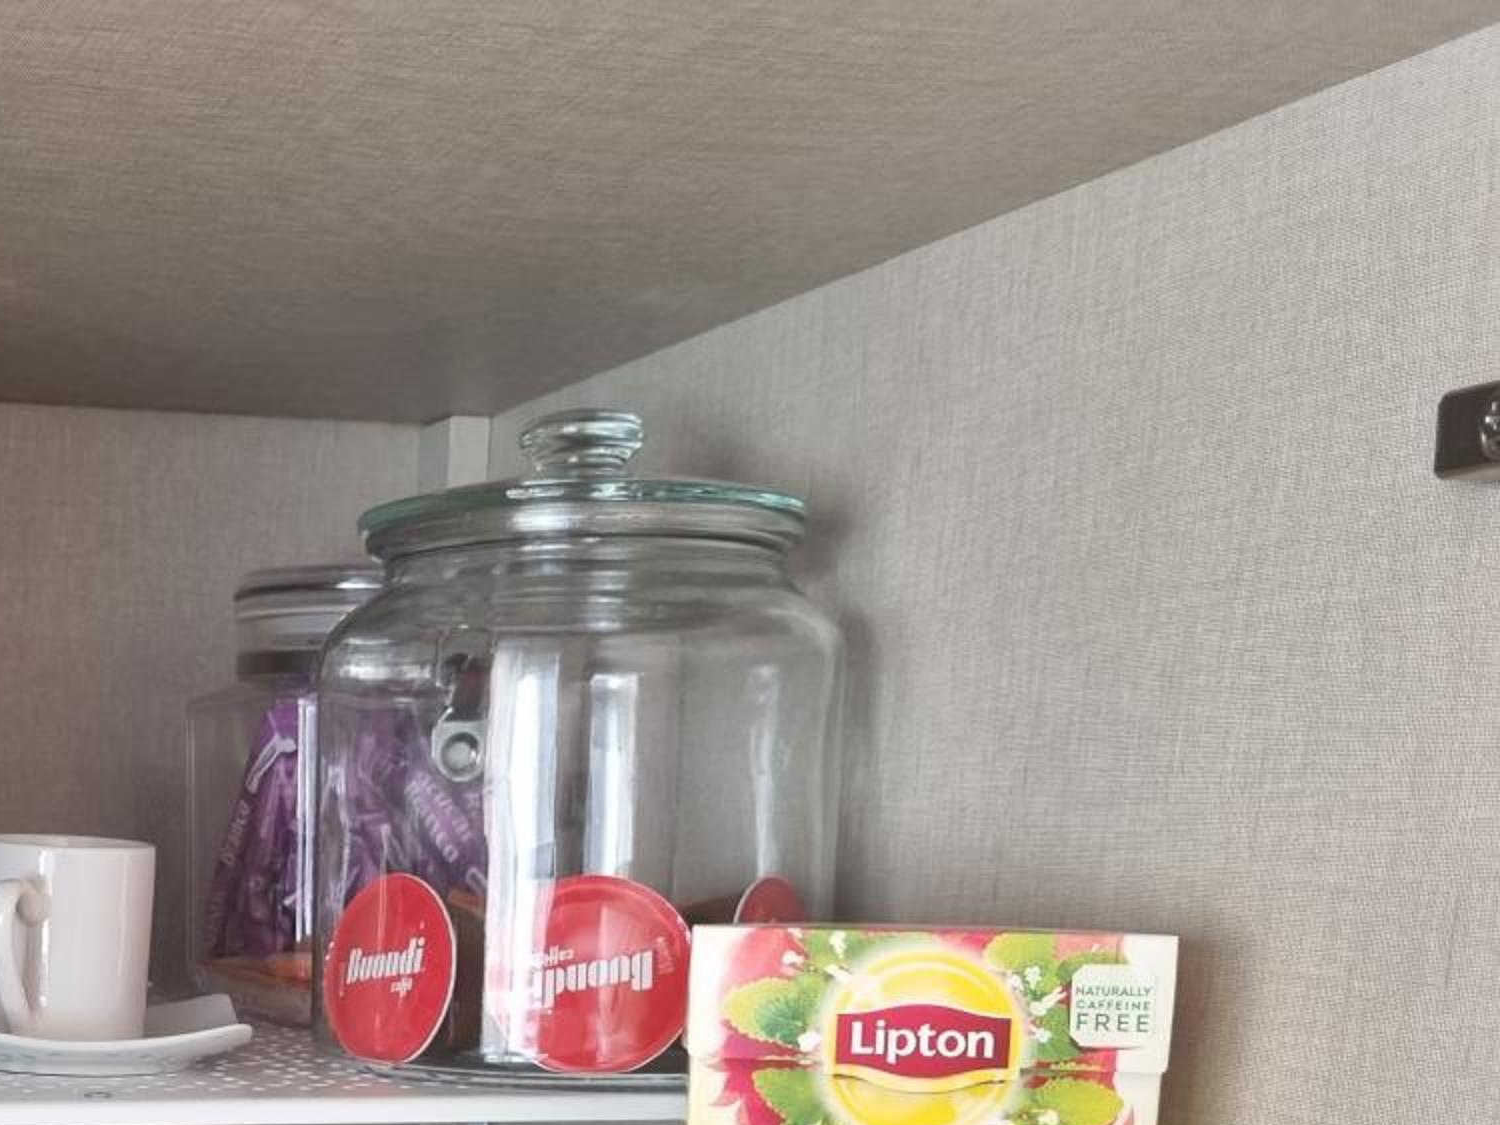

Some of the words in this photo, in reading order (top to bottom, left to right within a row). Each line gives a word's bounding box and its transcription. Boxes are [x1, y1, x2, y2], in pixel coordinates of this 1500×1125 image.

[346, 936, 425, 984] Buondi
[1076, 985, 1152, 997] NATURALLY
[1076, 999, 1151, 1011] CAFFEINE
[1076, 1012, 1150, 1033] FREE
[851, 1019, 995, 1064] Lipton
